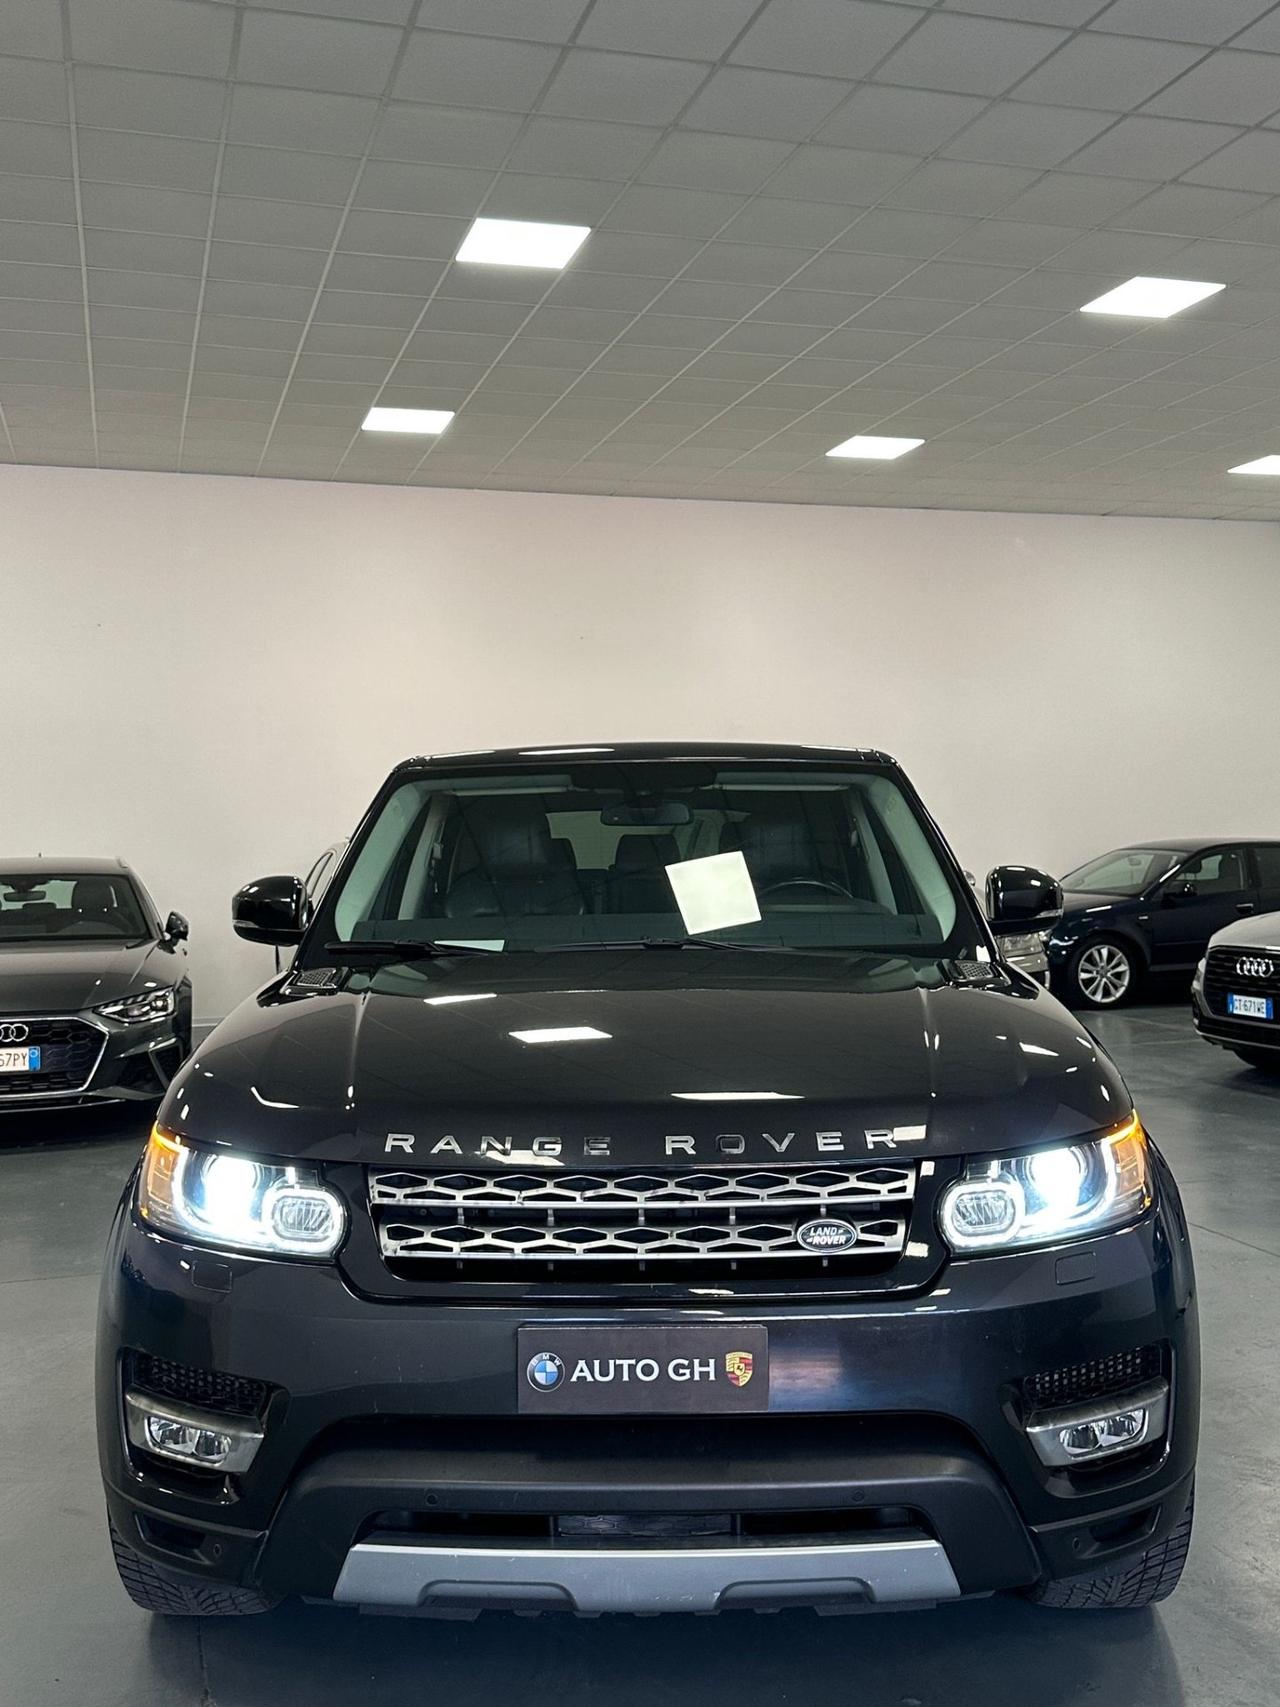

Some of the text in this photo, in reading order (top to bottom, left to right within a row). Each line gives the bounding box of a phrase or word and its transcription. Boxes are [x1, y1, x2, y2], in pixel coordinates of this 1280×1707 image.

[384, 1128, 897, 1156] RANGE ROVER
[810, 1226, 838, 1236] LAND
[812, 1235, 847, 1245] ROVER
[569, 1358, 716, 1382] AUTO GH
